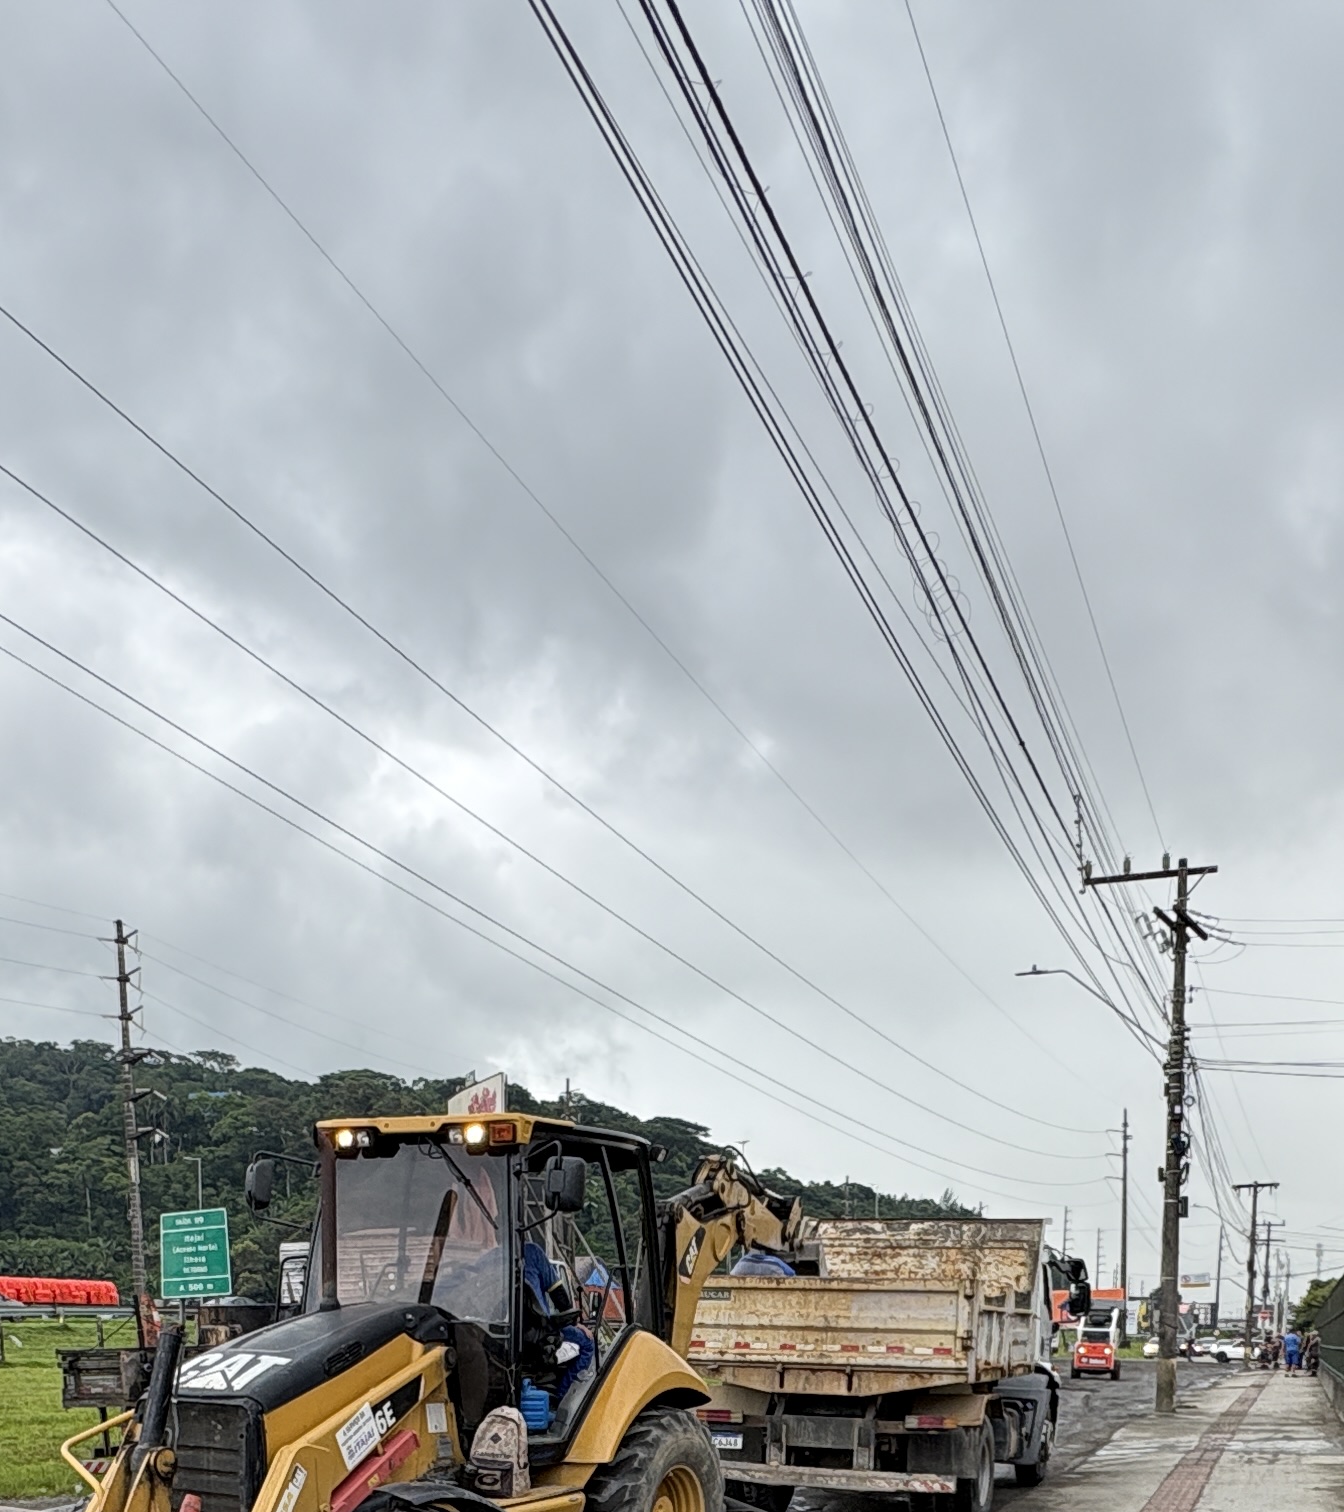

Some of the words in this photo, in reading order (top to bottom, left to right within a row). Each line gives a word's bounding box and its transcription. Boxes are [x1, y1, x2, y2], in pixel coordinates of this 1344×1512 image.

[685, 1236, 699, 1275] CAT
[188, 1283, 204, 1291] 500
[173, 1353, 293, 1391] CAT
[375, 1401, 397, 1434] 6E
